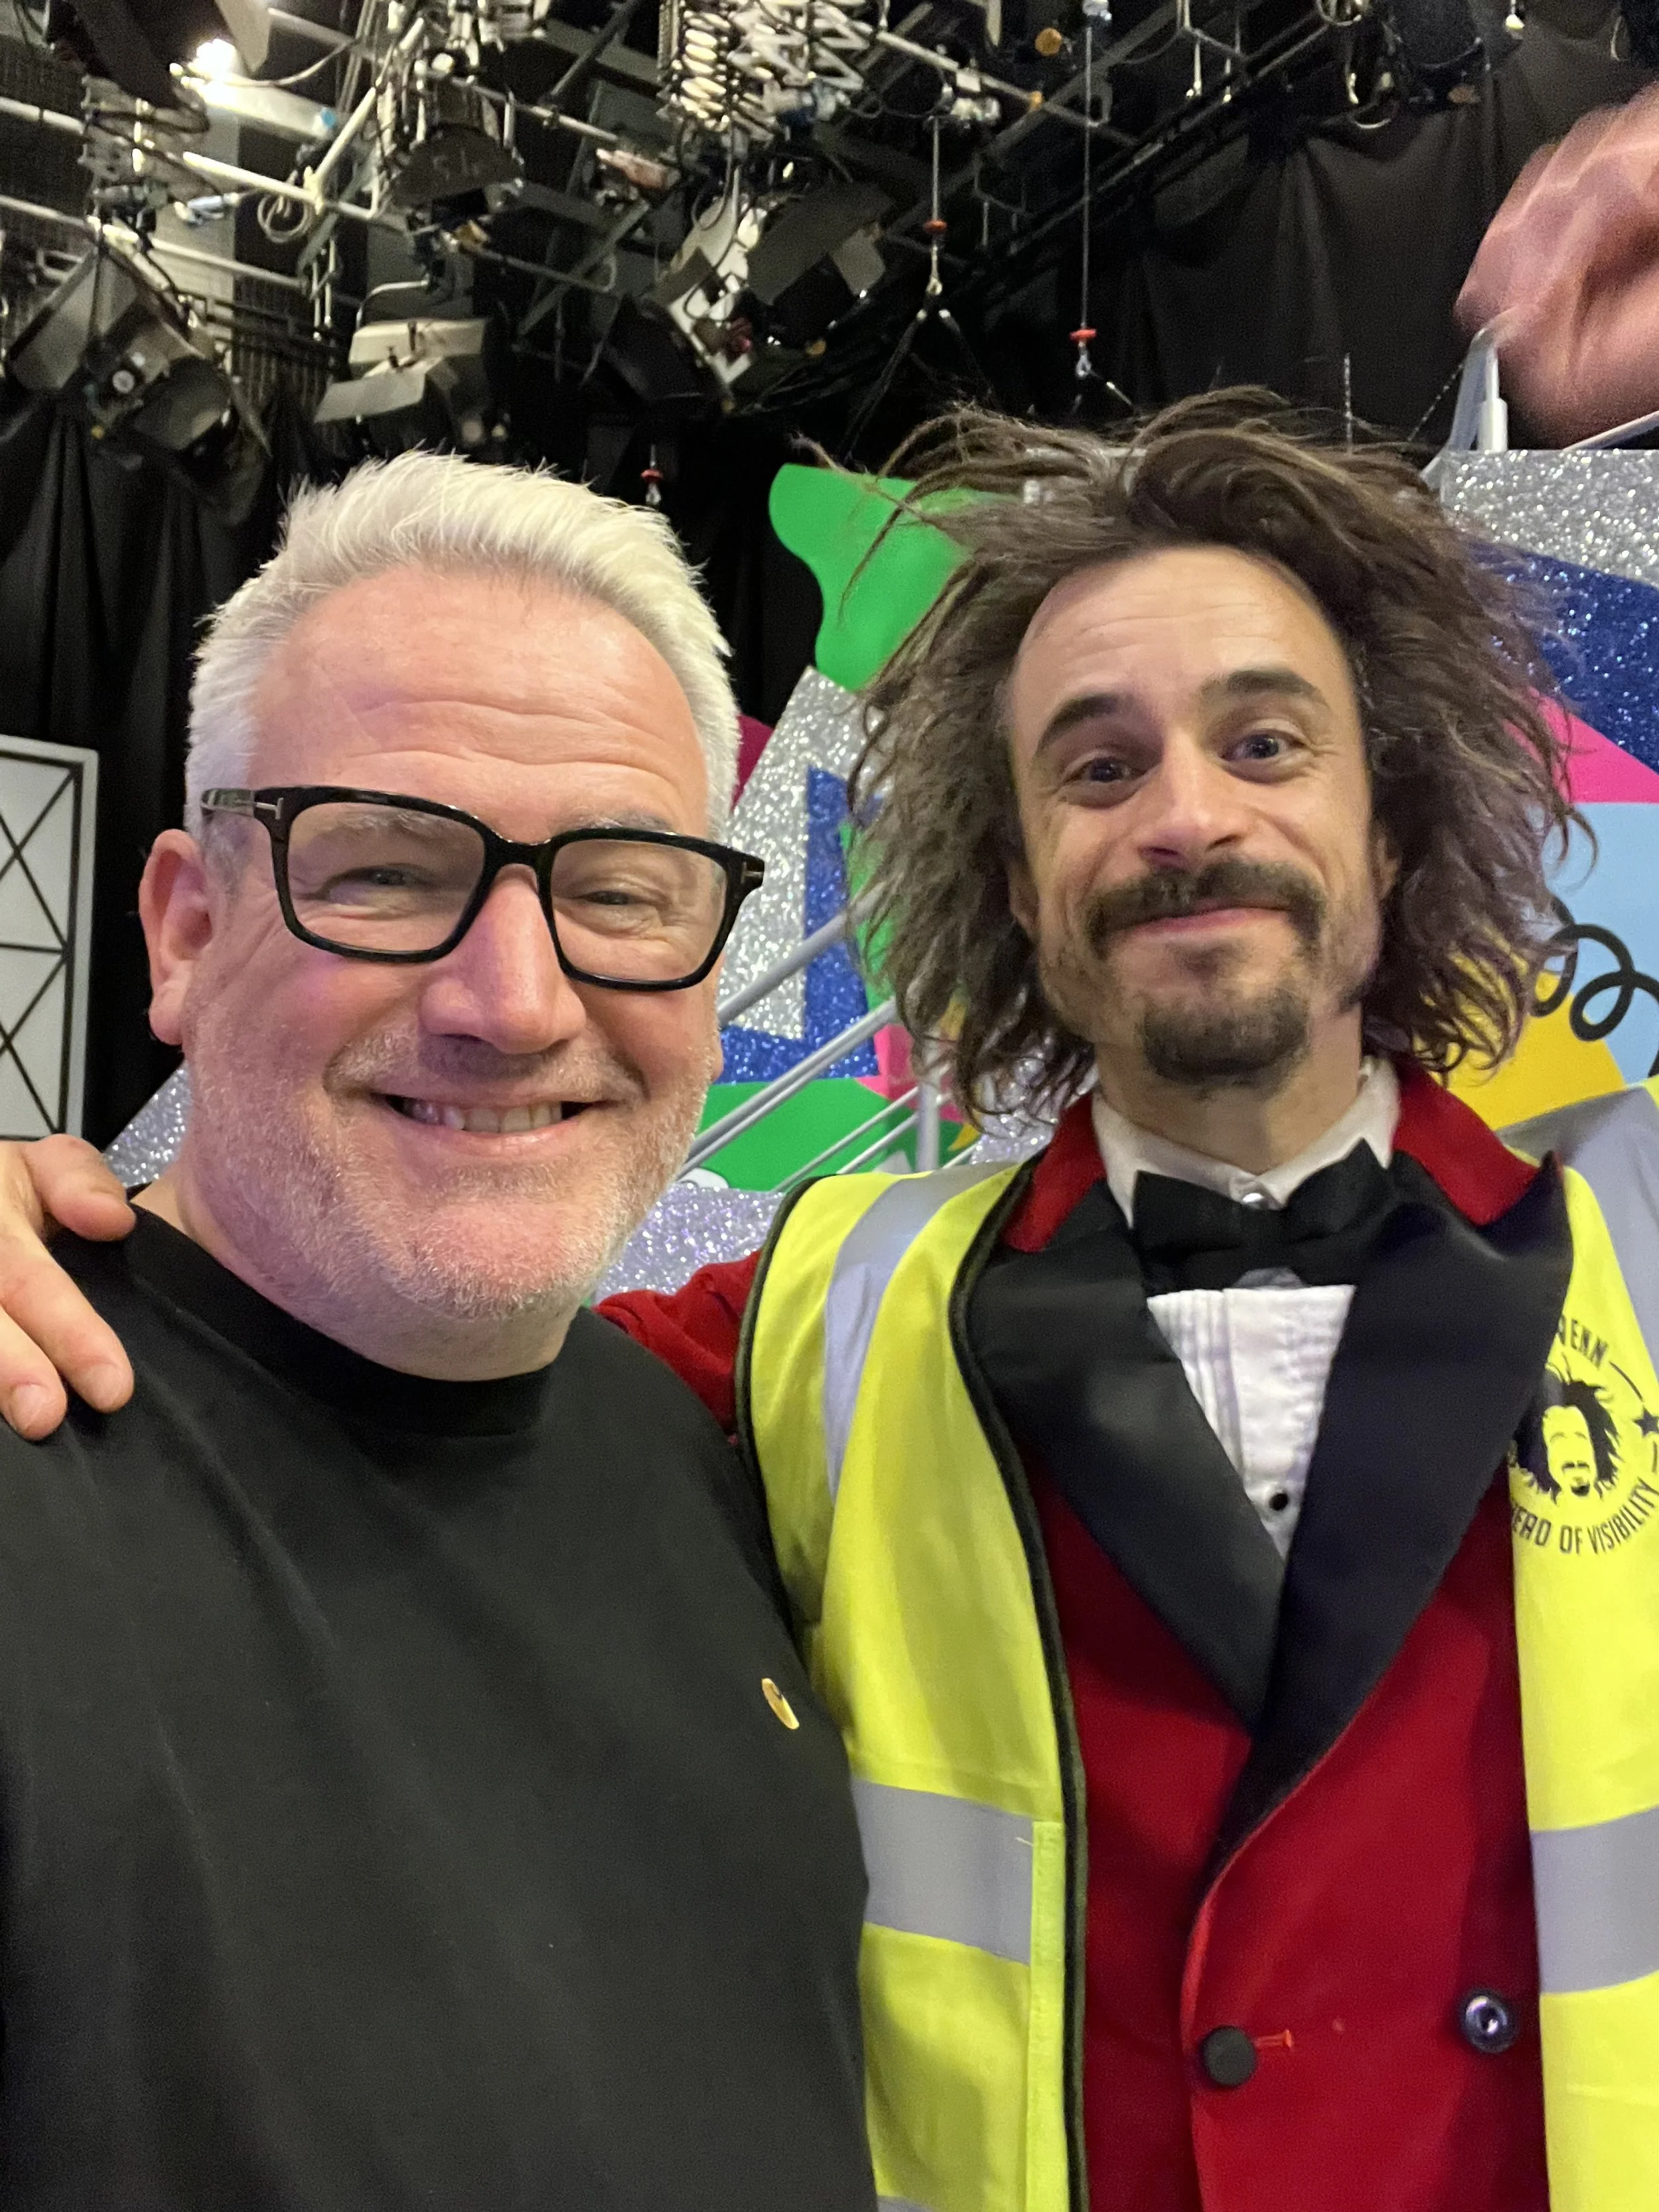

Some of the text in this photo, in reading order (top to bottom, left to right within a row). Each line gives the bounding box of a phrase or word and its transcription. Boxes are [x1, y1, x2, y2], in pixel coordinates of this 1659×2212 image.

[1512, 1477, 1659, 1554] ERO OF VISIBILITY
